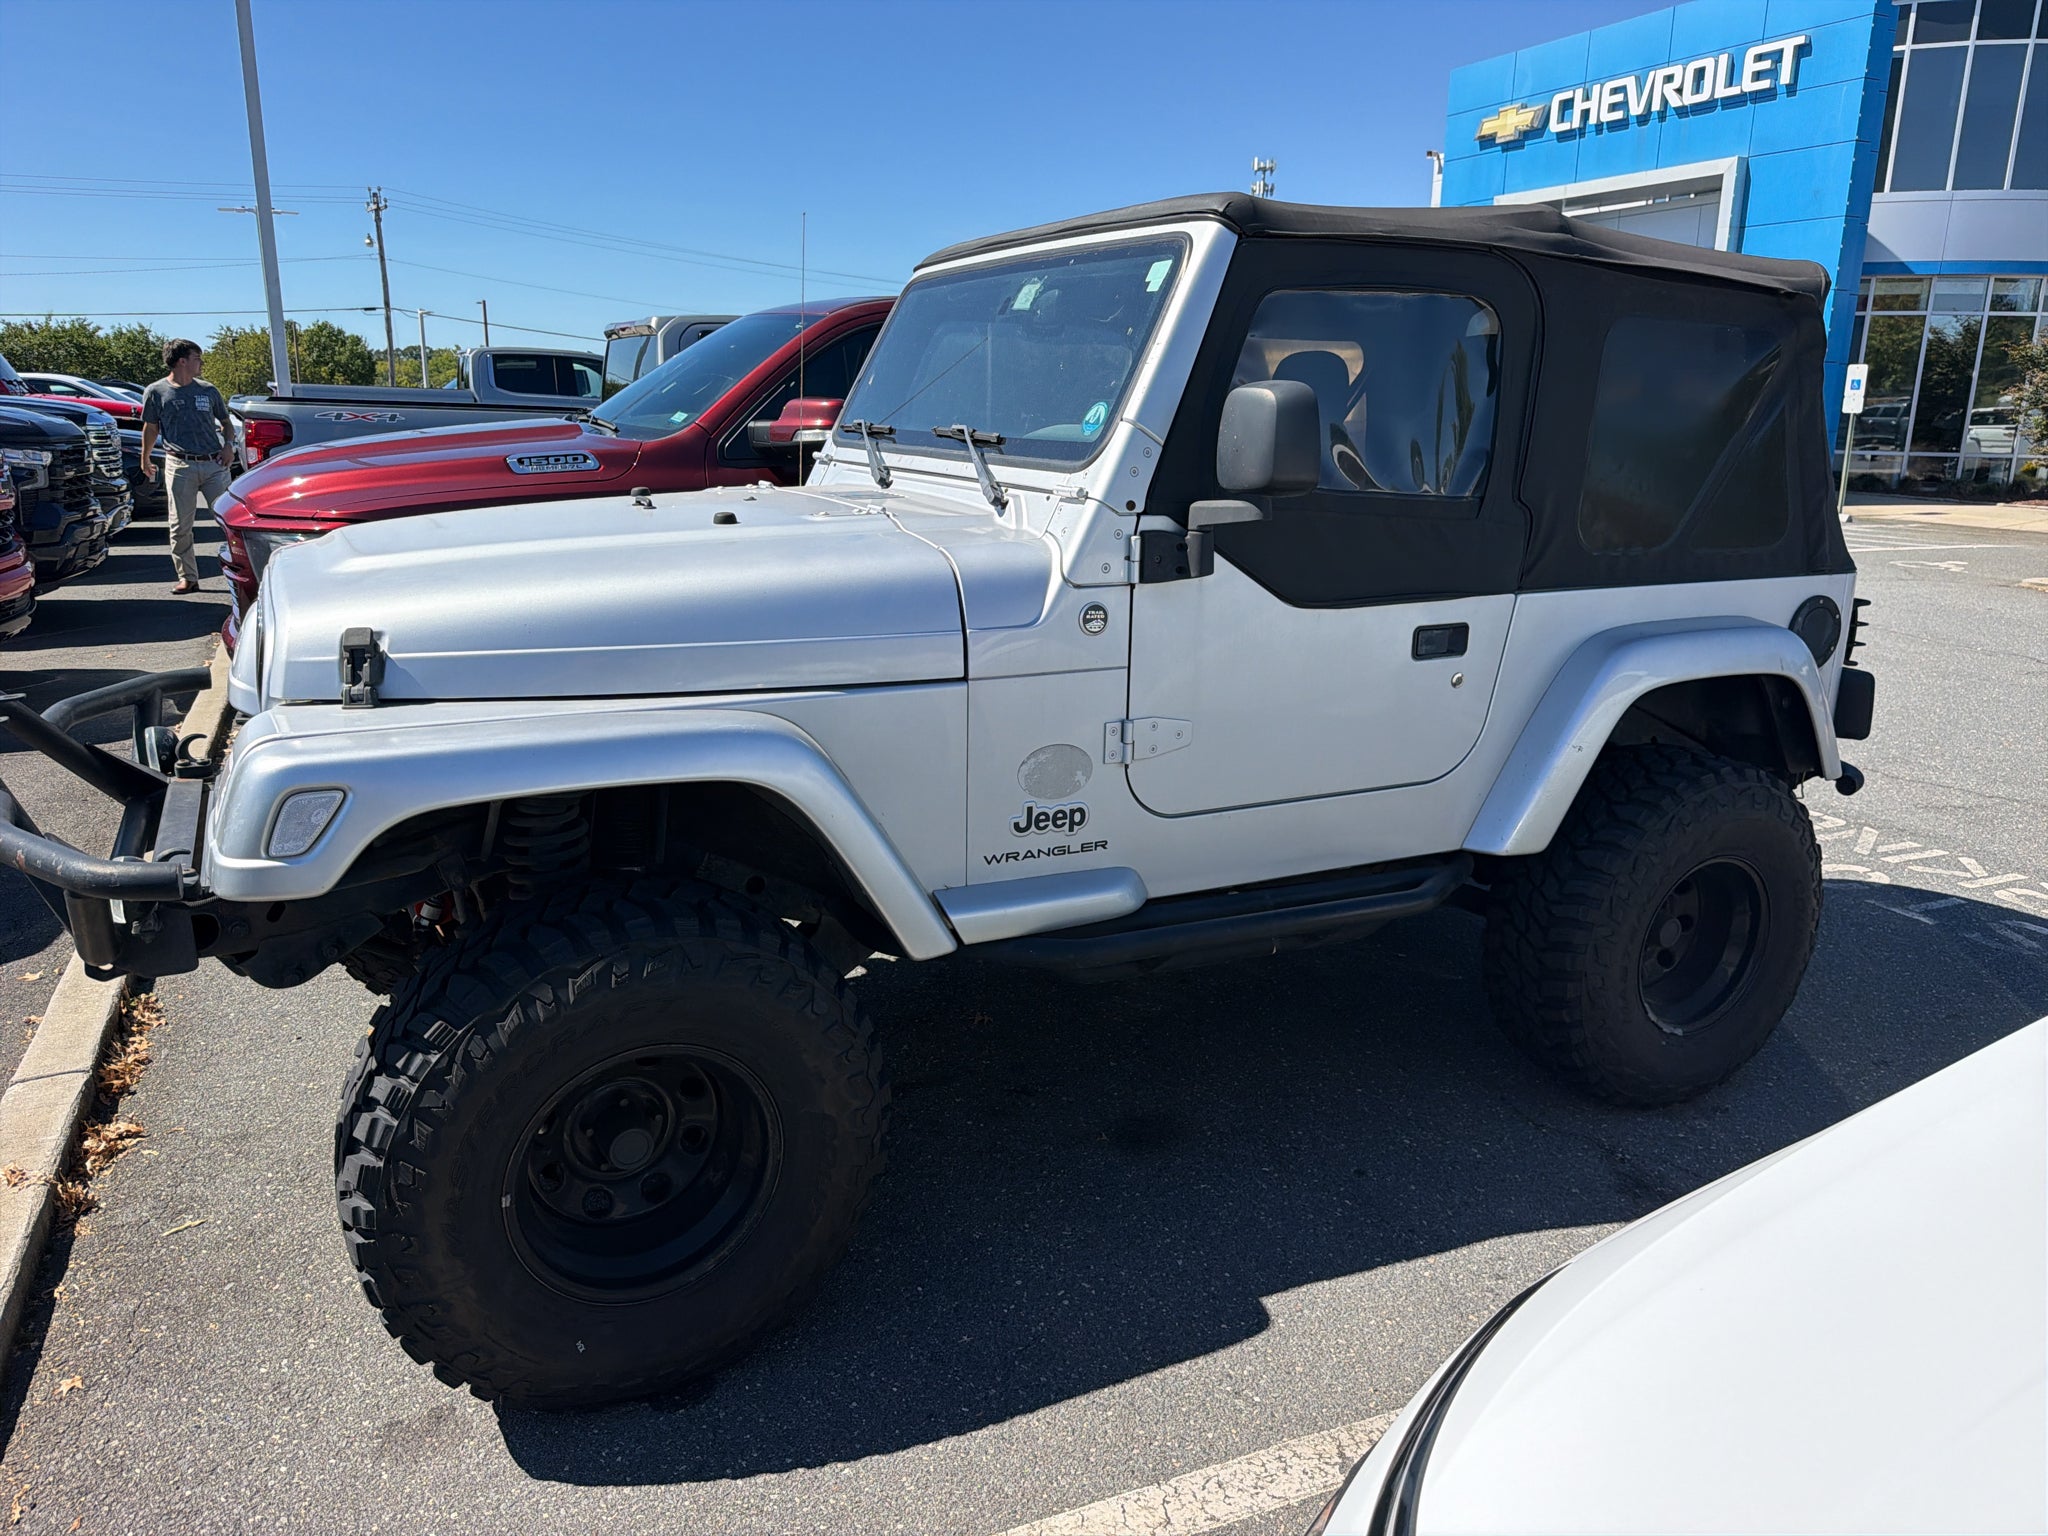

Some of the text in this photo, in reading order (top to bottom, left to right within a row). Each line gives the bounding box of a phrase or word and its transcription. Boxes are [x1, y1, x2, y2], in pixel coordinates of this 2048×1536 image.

[1550, 35, 1809, 133] CHEVROLET
[519, 456, 584, 466] 1500
[1013, 805, 1087, 833] Jeep
[983, 840, 1108, 865] WRANGLER
